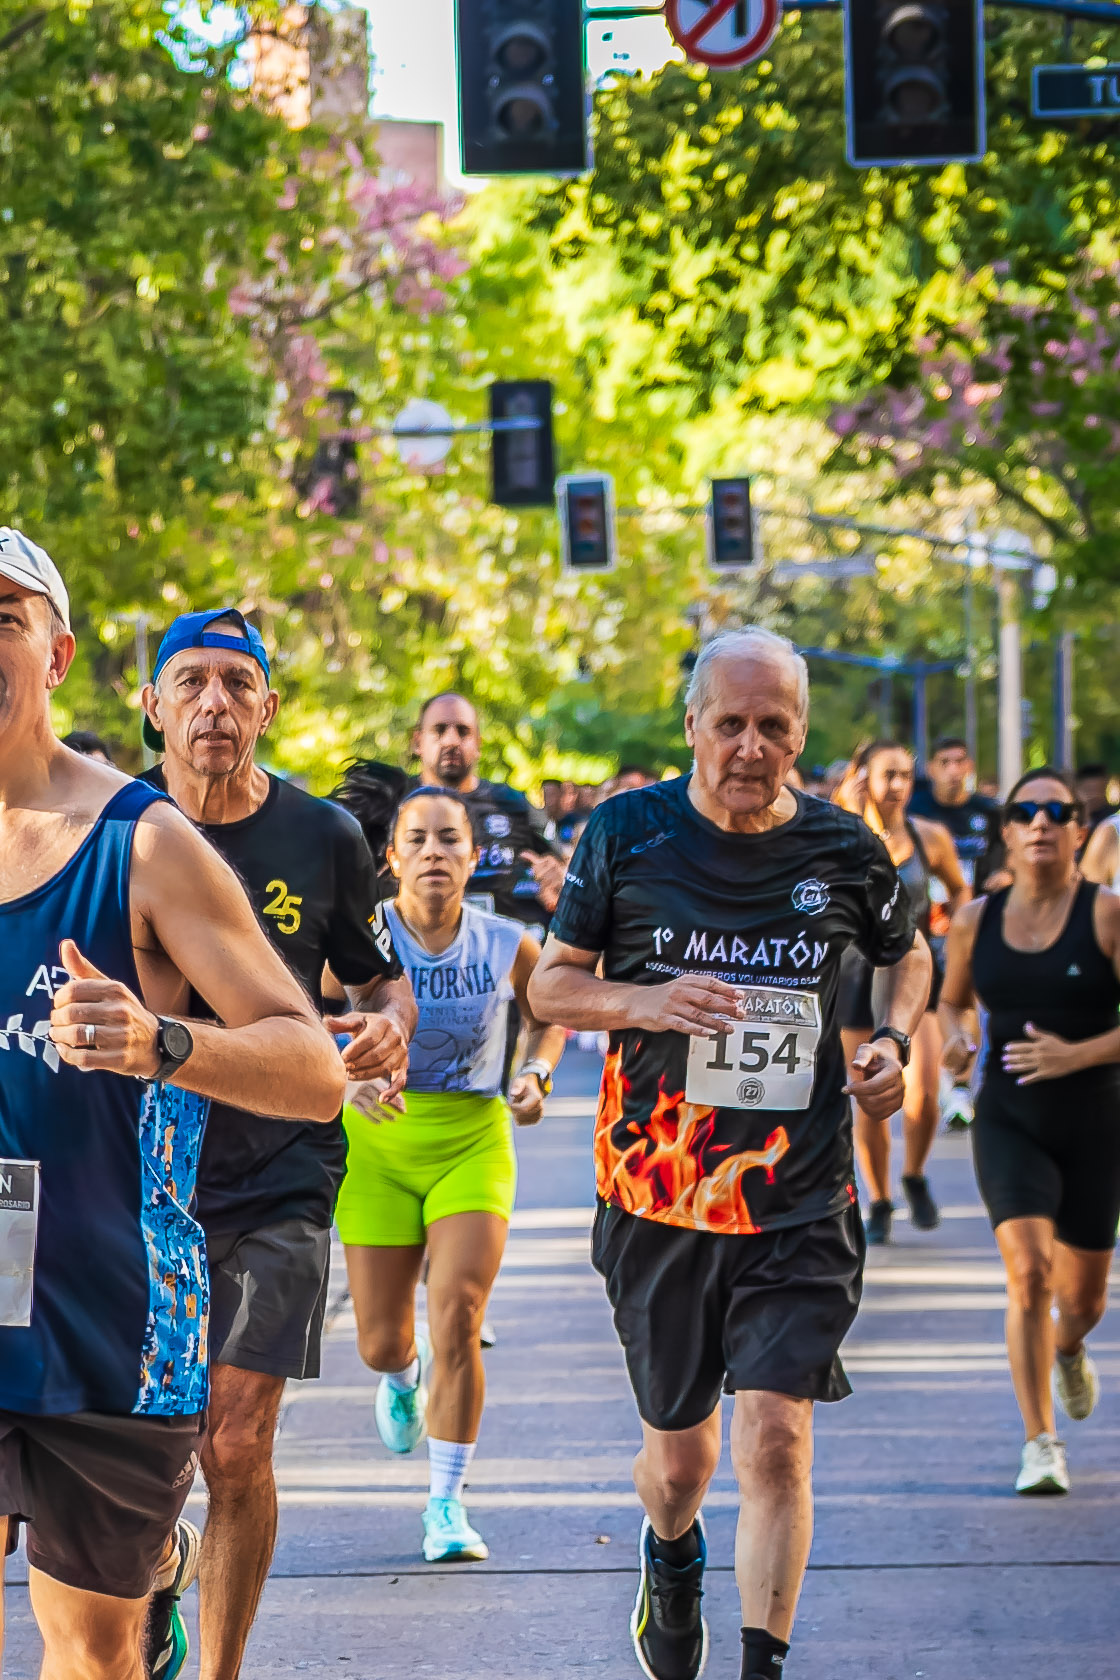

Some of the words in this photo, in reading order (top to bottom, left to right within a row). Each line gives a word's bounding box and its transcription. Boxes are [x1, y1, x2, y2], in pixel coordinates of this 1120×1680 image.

[263, 880, 302, 934] 25
[684, 930, 829, 969] MARATÓN
[738, 973, 799, 987] VOLUNTARIOS
[736, 997, 803, 1016] ARATÓN
[706, 1030, 801, 1075] 154
